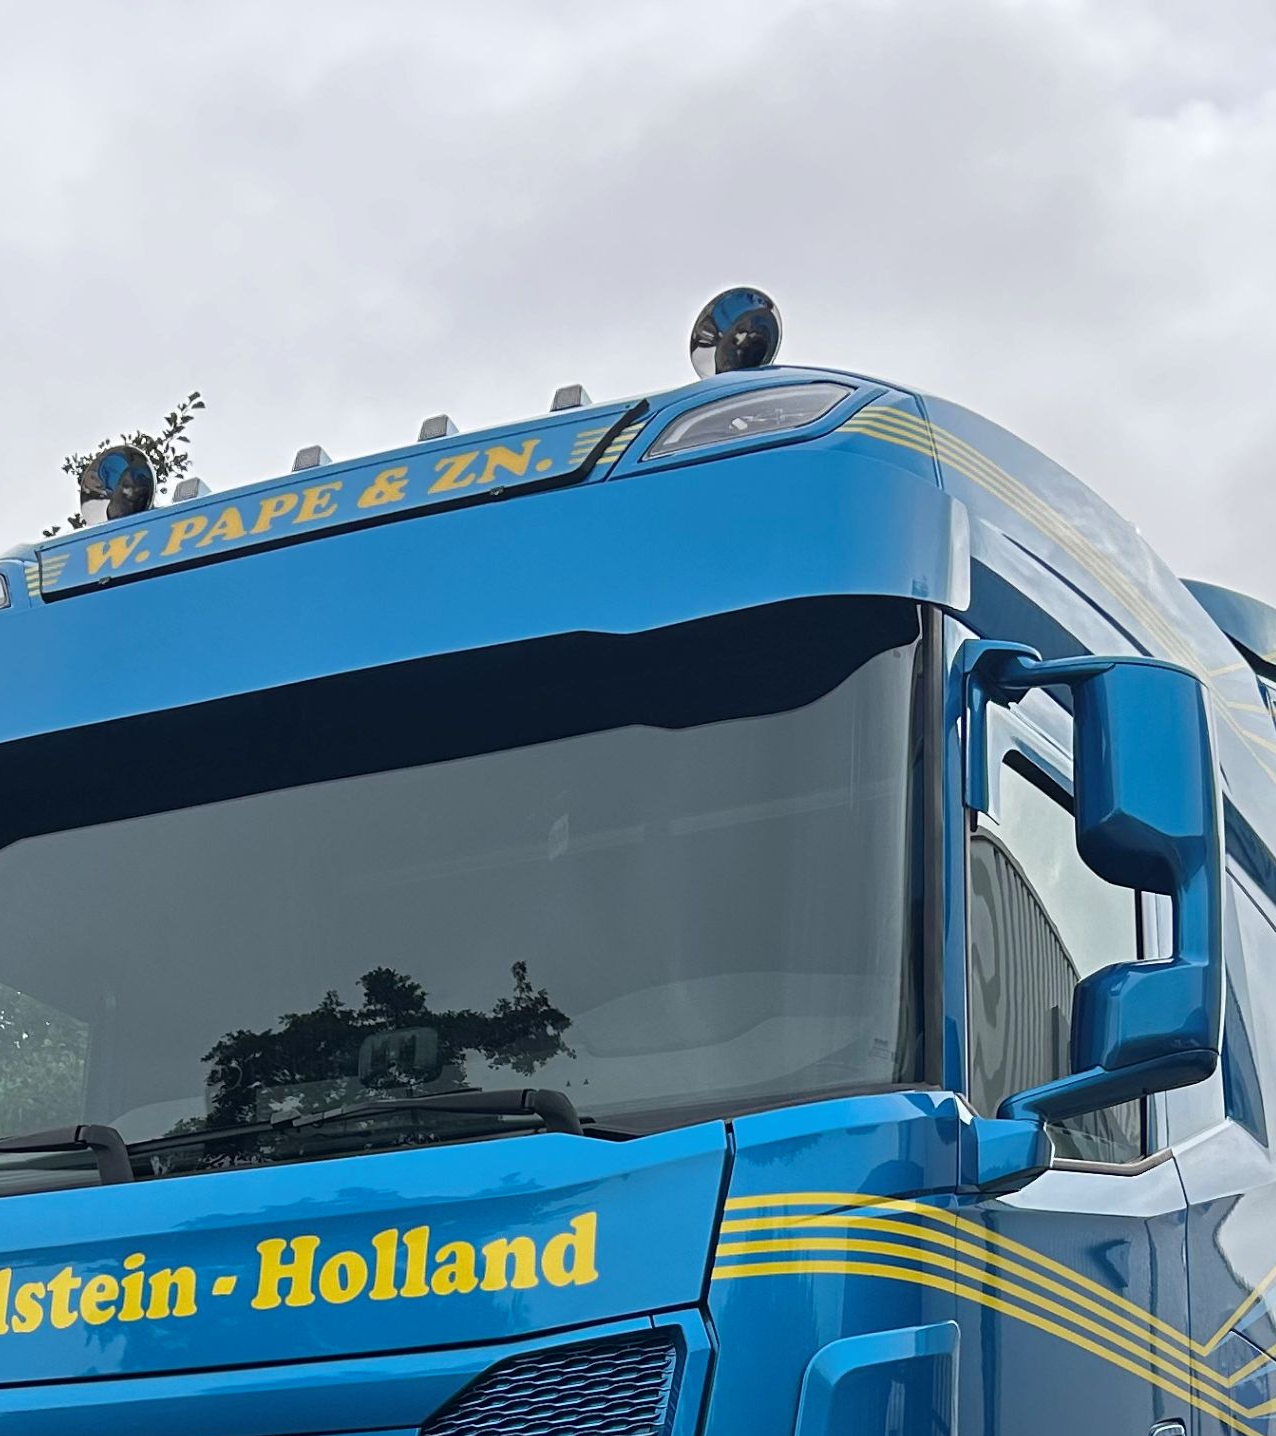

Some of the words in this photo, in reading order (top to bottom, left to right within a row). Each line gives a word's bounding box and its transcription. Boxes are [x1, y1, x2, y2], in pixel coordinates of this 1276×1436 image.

[86, 530, 151, 575] W.
[160, 480, 342, 557] PAPE
[357, 465, 410, 509] &
[426, 438, 553, 495] ZN.
[250, 1211, 600, 1312] Holland
